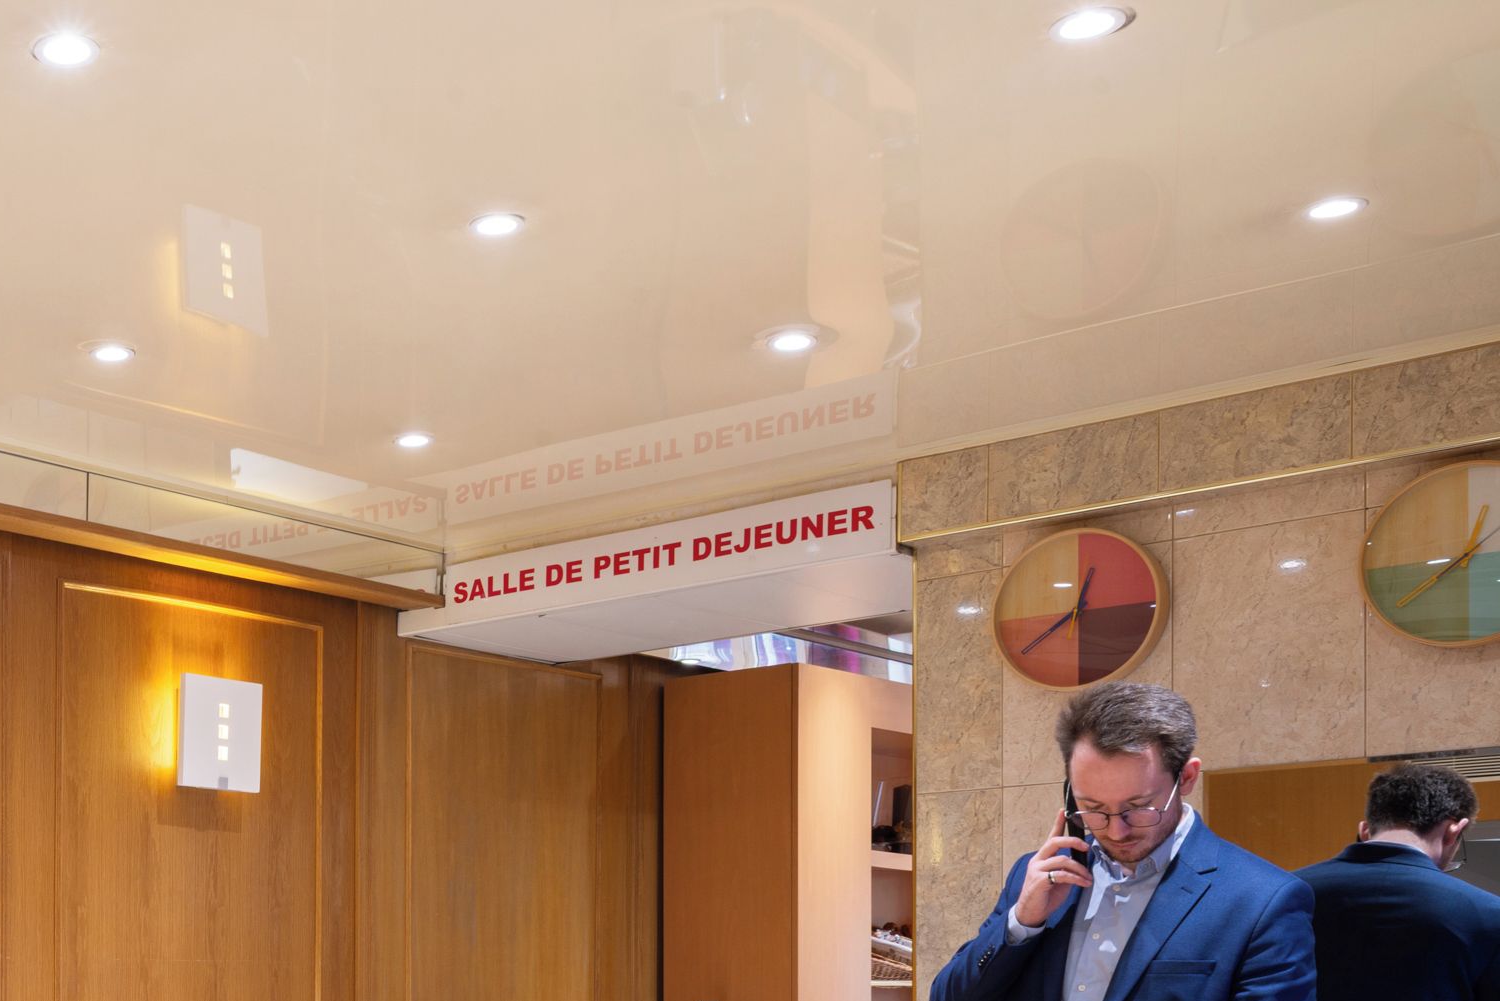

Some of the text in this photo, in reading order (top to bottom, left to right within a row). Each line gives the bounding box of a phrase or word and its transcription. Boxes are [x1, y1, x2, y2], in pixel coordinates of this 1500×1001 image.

[453, 505, 875, 604] SALLE DE PETIT DEJEUNER
